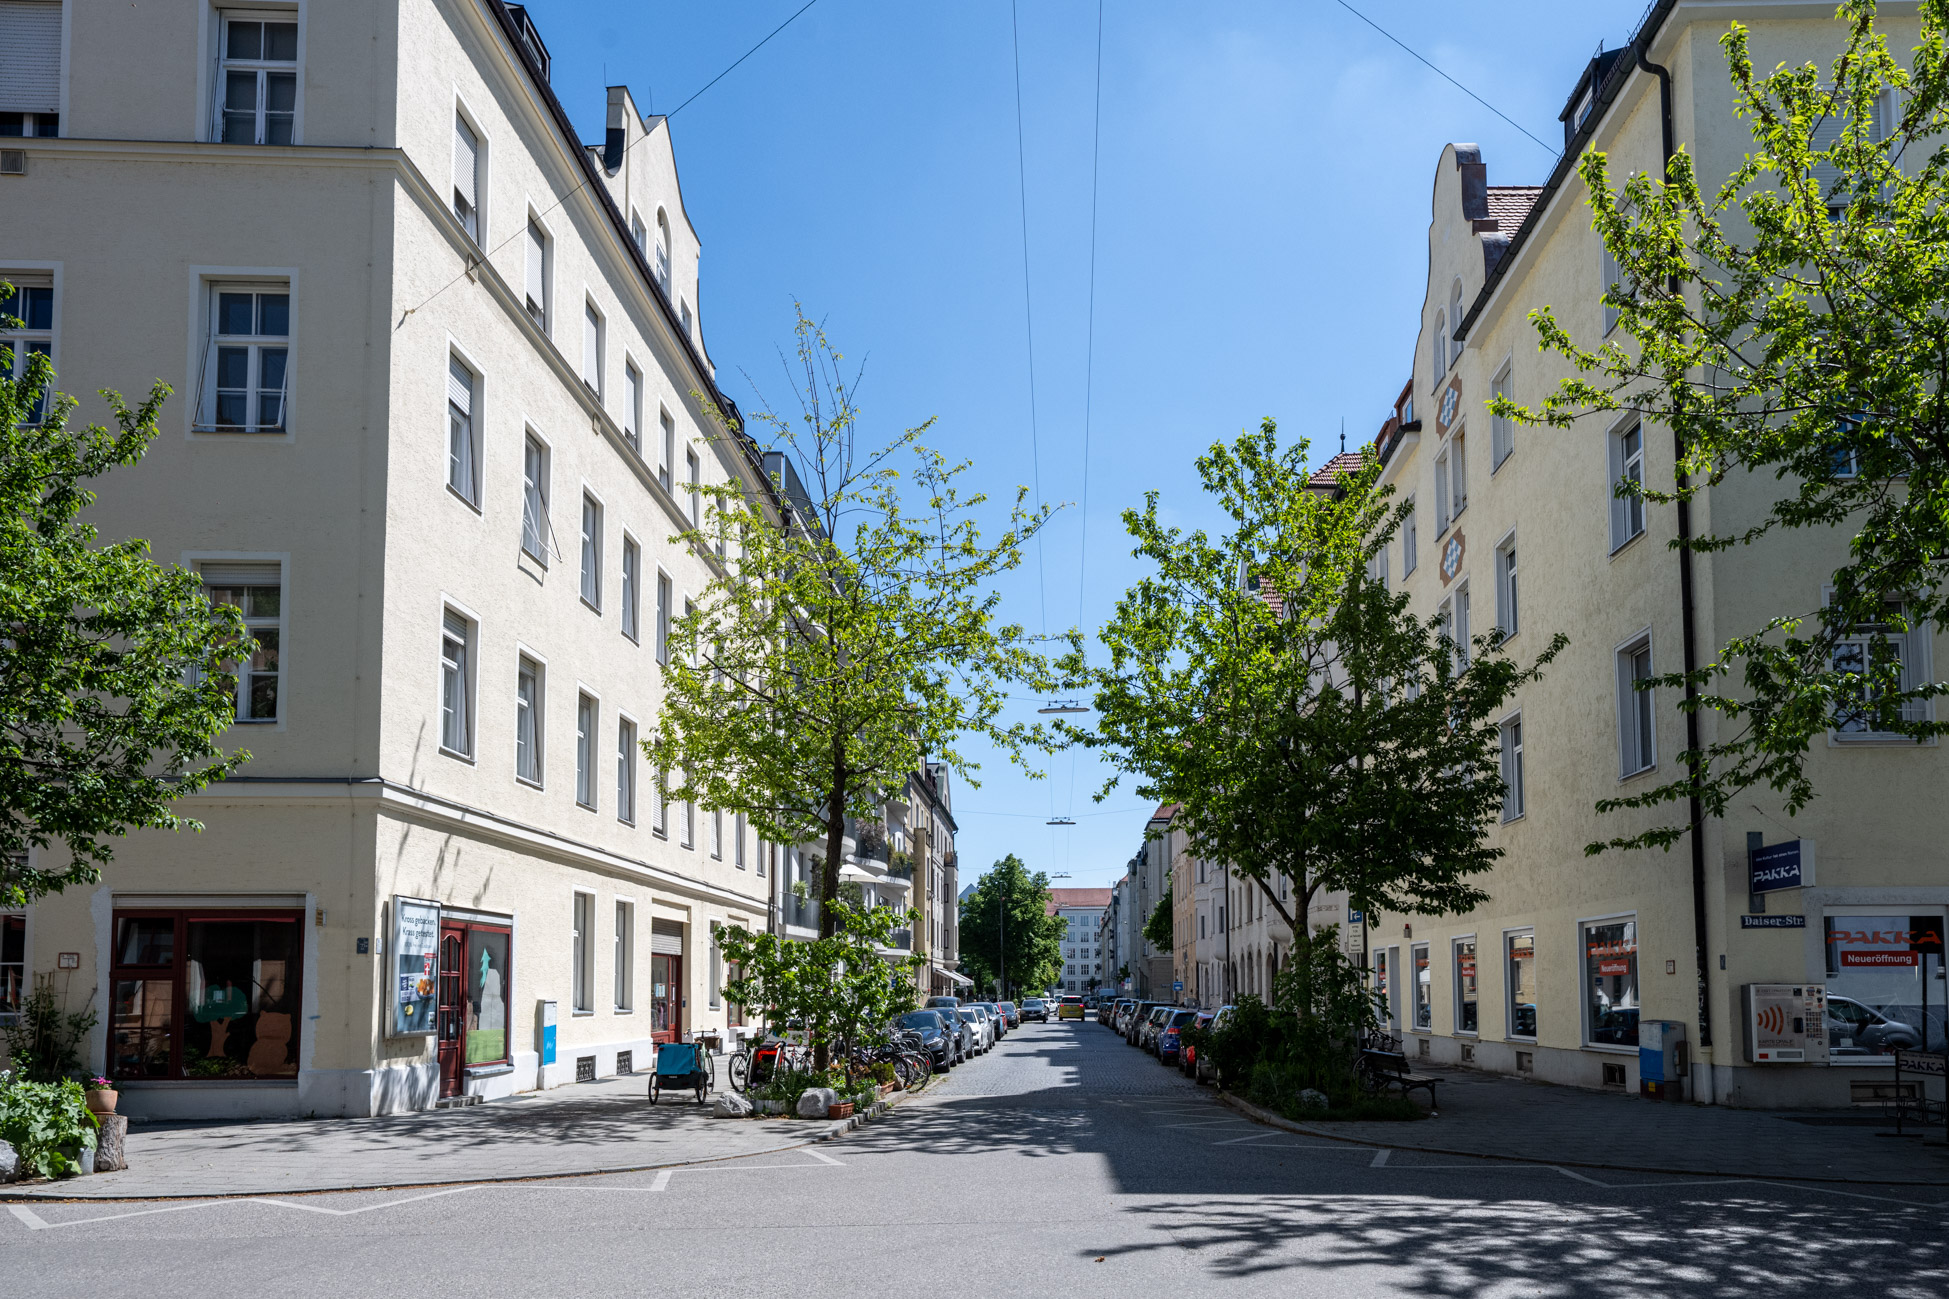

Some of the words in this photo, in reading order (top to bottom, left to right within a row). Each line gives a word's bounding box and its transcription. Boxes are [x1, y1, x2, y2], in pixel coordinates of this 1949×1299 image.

[1753, 865, 1800, 883] PAKKA
[401, 913, 415, 924] Kross
[1744, 916, 1804, 926] Daiser-Str.
[402, 926, 415, 937] Krass
[1827, 930, 1942, 945] PAKKA
[1847, 953, 1912, 965] Neueröffnung
[1899, 1059, 1946, 1073] PAKKA
